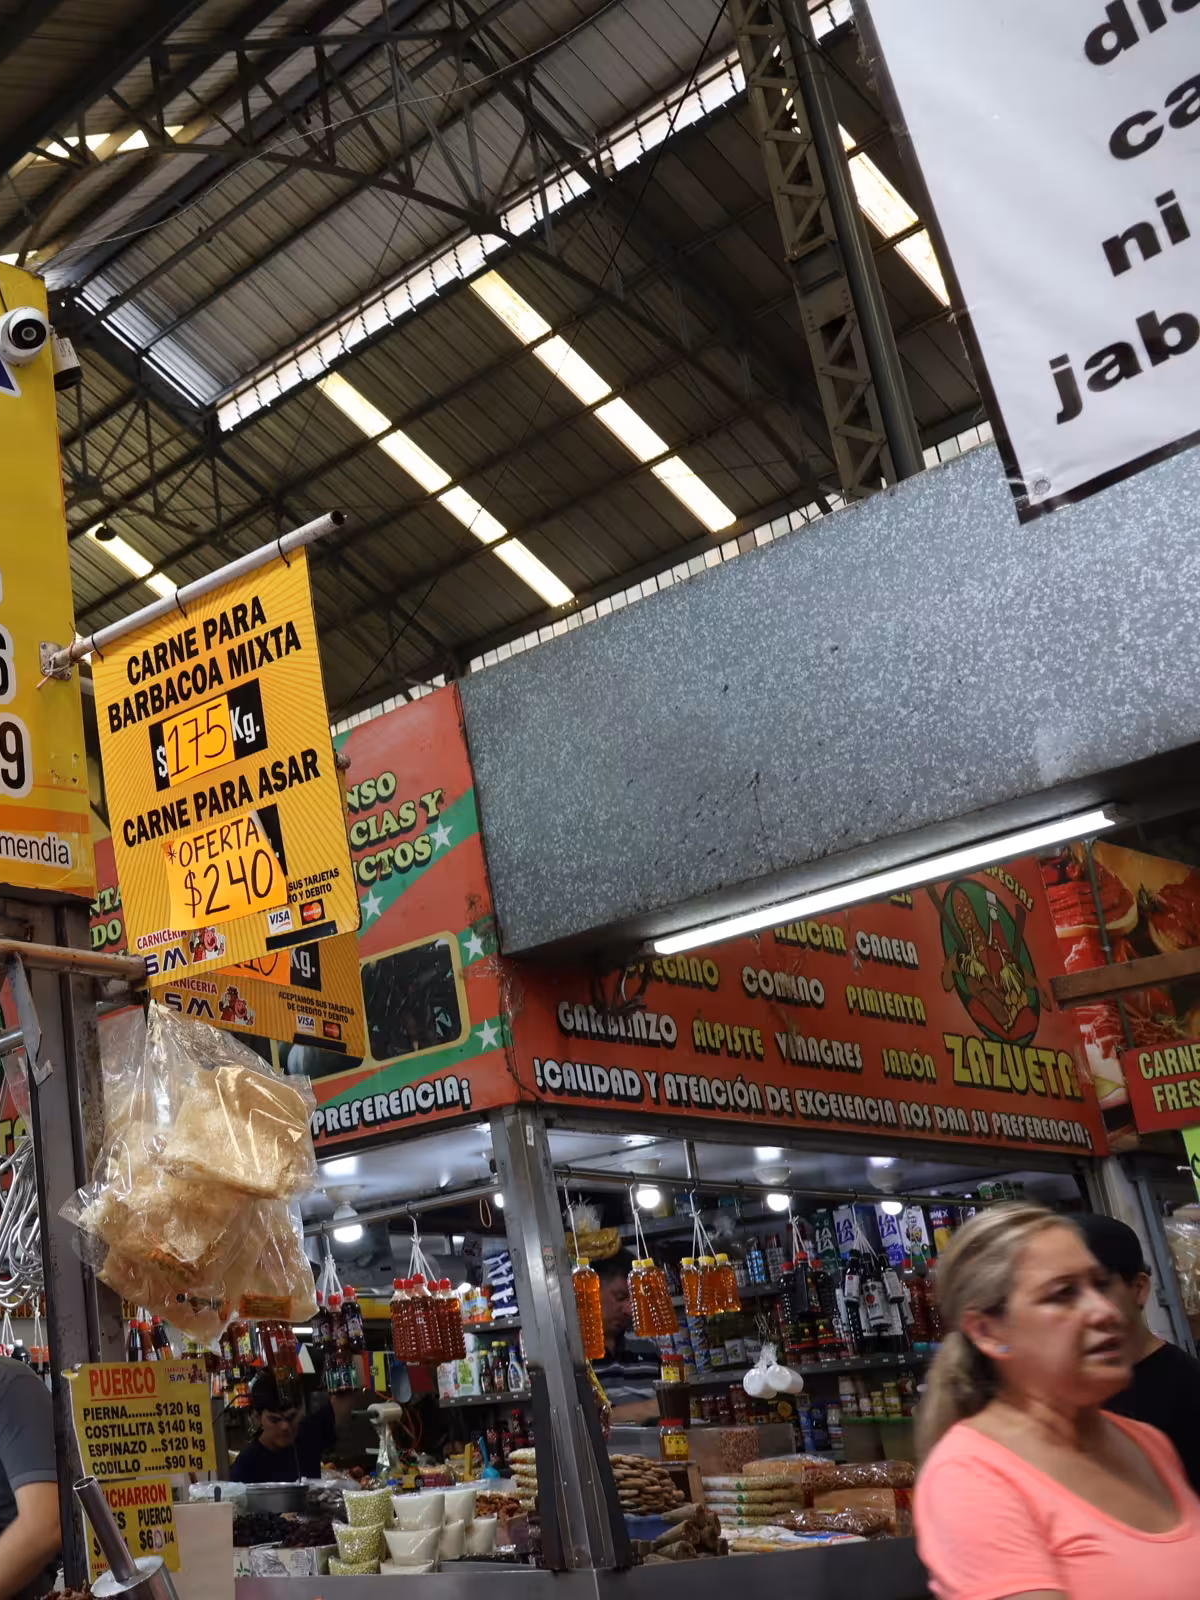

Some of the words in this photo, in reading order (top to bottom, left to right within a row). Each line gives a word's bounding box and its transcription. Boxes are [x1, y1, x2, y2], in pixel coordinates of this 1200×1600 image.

[1084, 0, 1200, 65] di
[1101, 189, 1191, 277] ni
[127, 627, 199, 685] CARNE
[203, 595, 267, 650] PARA
[107, 657, 224, 734] BARBACOA
[226, 620, 302, 680] MIXTA
[230, 706, 260, 743] Kg.
[123, 803, 191, 848] CARNE
[194, 774, 257, 822] PARA
[258, 748, 320, 798] ASAR
[420, 788, 445, 817] Y
[184, 848, 274, 919] $240
[288, 879, 303, 892] SUS
[304, 868, 339, 887] TARJETAS
[305, 883, 332, 899] DEBITO
[269, 910, 290, 925] VISA
[144, 947, 188, 976] SM
[856, 929, 919, 966] CANELA
[165, 992, 214, 1019] SM
[278, 991, 314, 1006] ACEPTAMOS
[316, 999, 328, 1009] SUS
[328, 1001, 354, 1016] TARJETAS
[287, 1002, 296, 1011] DE
[742, 965, 825, 1005] COMINO
[846, 984, 927, 1022] PIMIENTA
[298, 1016, 315, 1027] VISA
[693, 1019, 764, 1055] ALPISTE
[776, 1032, 863, 1070] VINAGRES
[882, 1047, 937, 1080] JABÓN
[943, 1032, 1083, 1099] ZAZUETA
[643, 1071, 658, 1098] Y
[663, 1073, 762, 1109] ATENCIÓN
[765, 1085, 792, 1113] DE
[796, 1088, 897, 1124] EXCELENCIA
[899, 1102, 932, 1128] NOS
[936, 1106, 969, 1131] DAN
[971, 1110, 990, 1135] SU
[89, 1366, 156, 1397] PUERCO
[186, 1401, 200, 1417] kg
[85, 1423, 155, 1440] COSTILLITA
[158, 1420, 186, 1436] $140
[189, 1419, 203, 1435] kg
[88, 1441, 147, 1458] ESPINAZO
[192, 1437, 206, 1453] kg
[92, 1459, 141, 1476] CODILLO
[189, 1456, 203, 1471] kg
[138, 1505, 172, 1527] PUERCO
